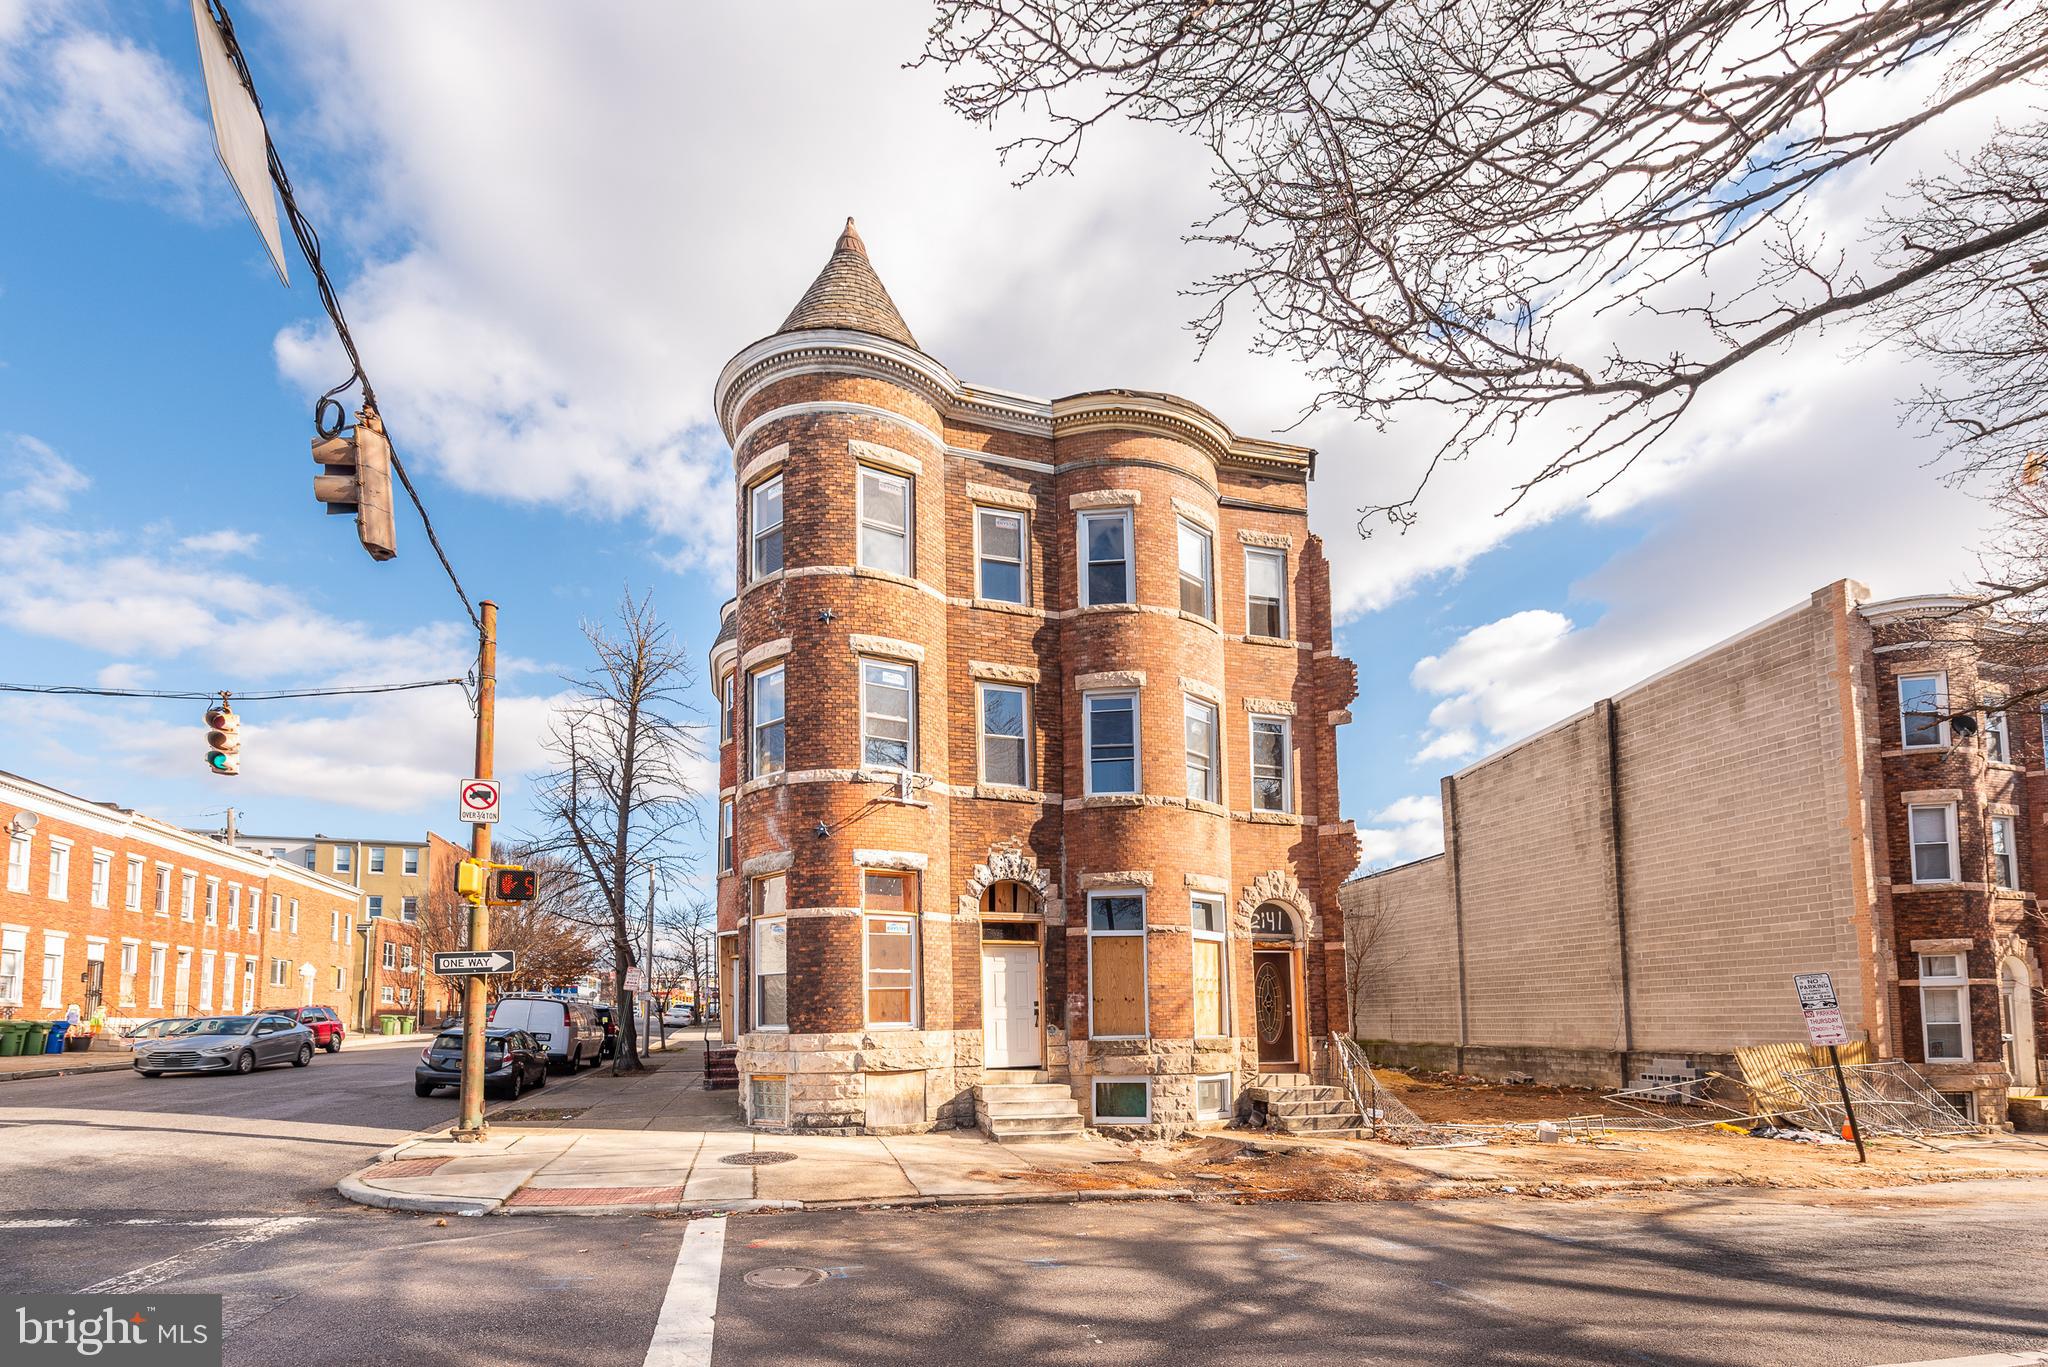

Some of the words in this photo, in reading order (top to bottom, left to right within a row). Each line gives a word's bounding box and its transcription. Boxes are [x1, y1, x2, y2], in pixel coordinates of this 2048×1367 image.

[476, 811, 485, 820] 3/4
[524, 876, 534, 895] 5
[1251, 911, 1282, 931] 2141
[442, 959, 465, 968] ONE
[468, 958, 490, 967] WAY
